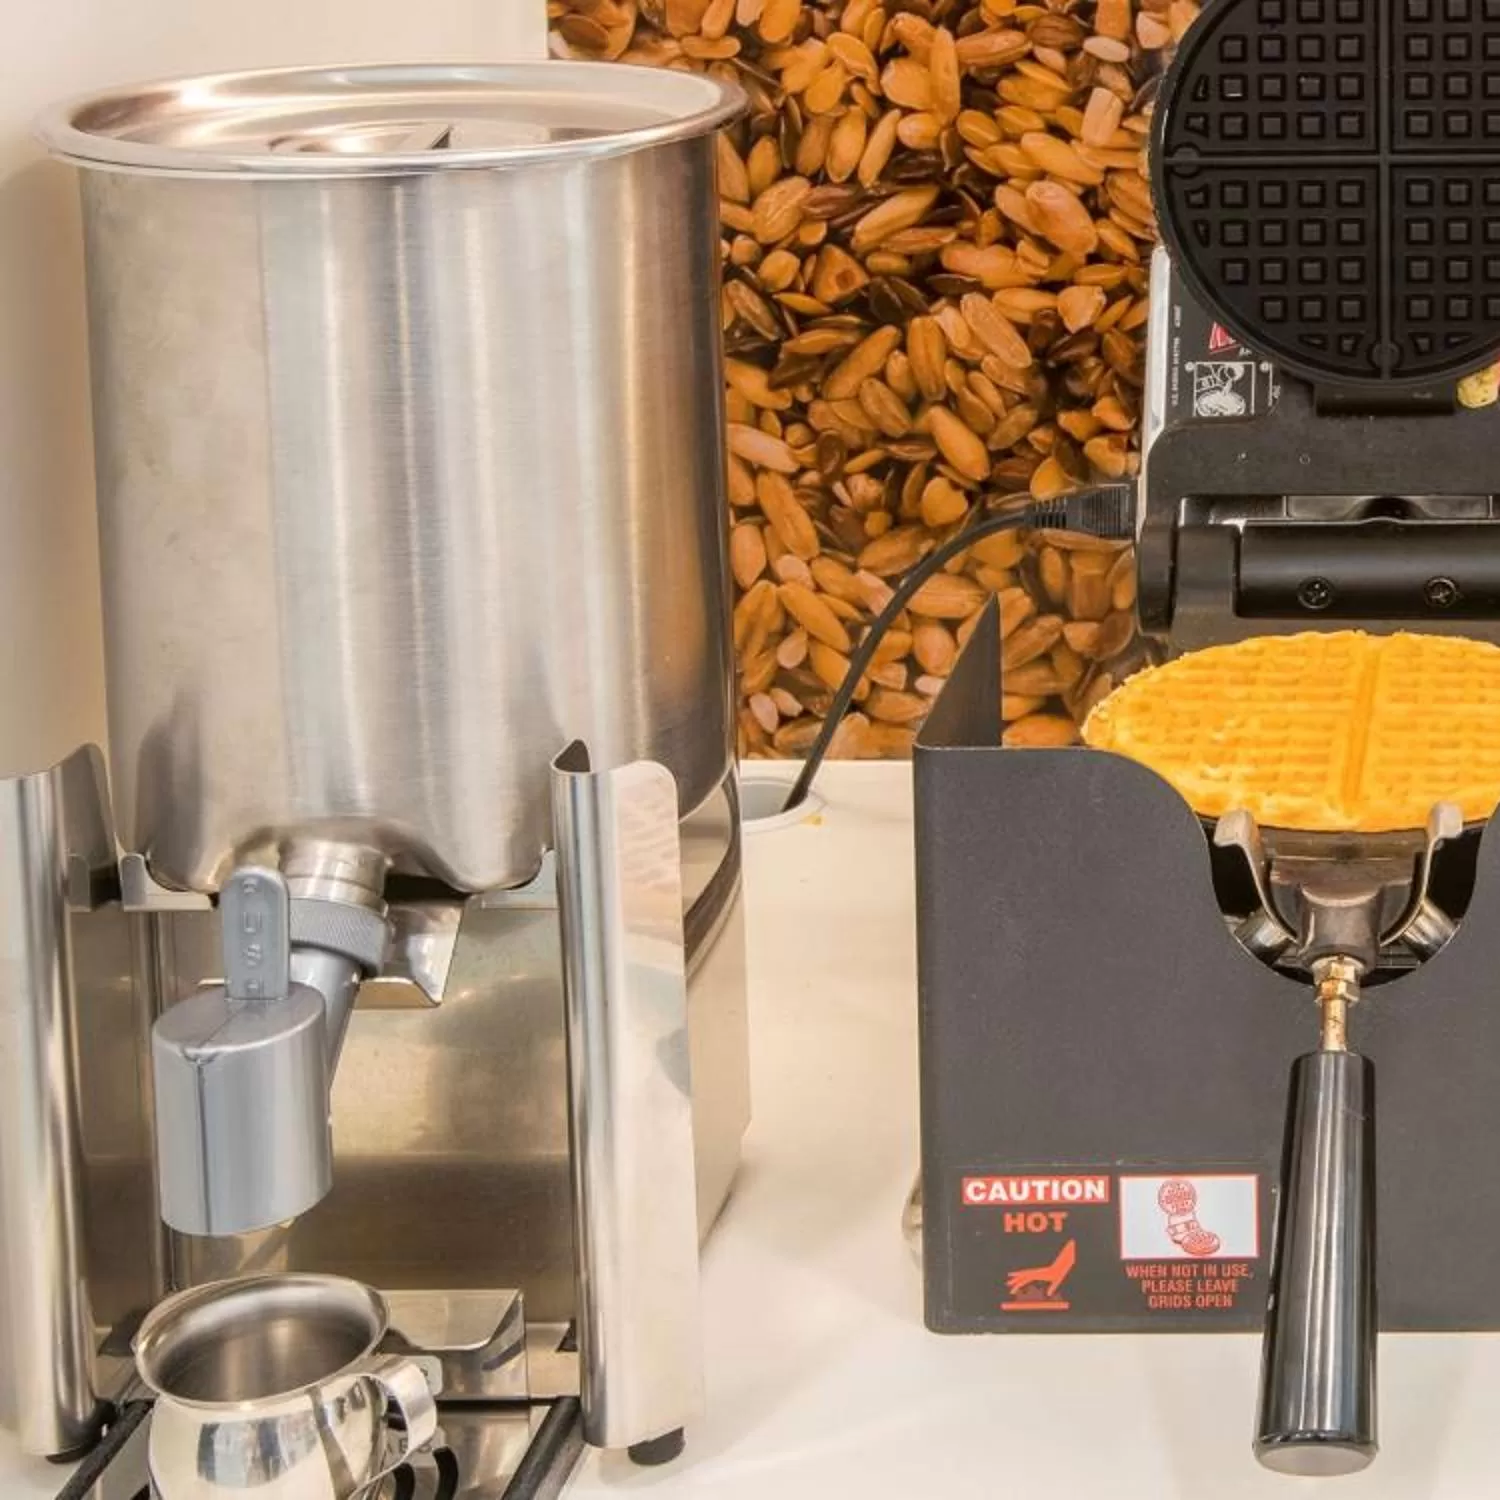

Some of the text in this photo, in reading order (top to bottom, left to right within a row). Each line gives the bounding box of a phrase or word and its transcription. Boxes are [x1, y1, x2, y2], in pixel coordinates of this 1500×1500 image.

[965, 1179, 1106, 1202] CAUTION
[1003, 1211, 1069, 1233] HOT
[1125, 1263, 1254, 1279] WHEN NOT IN USE,
[1141, 1279, 1239, 1293] PLEASE LEAVE
[1148, 1295, 1233, 1308] GRIDS OPEN
